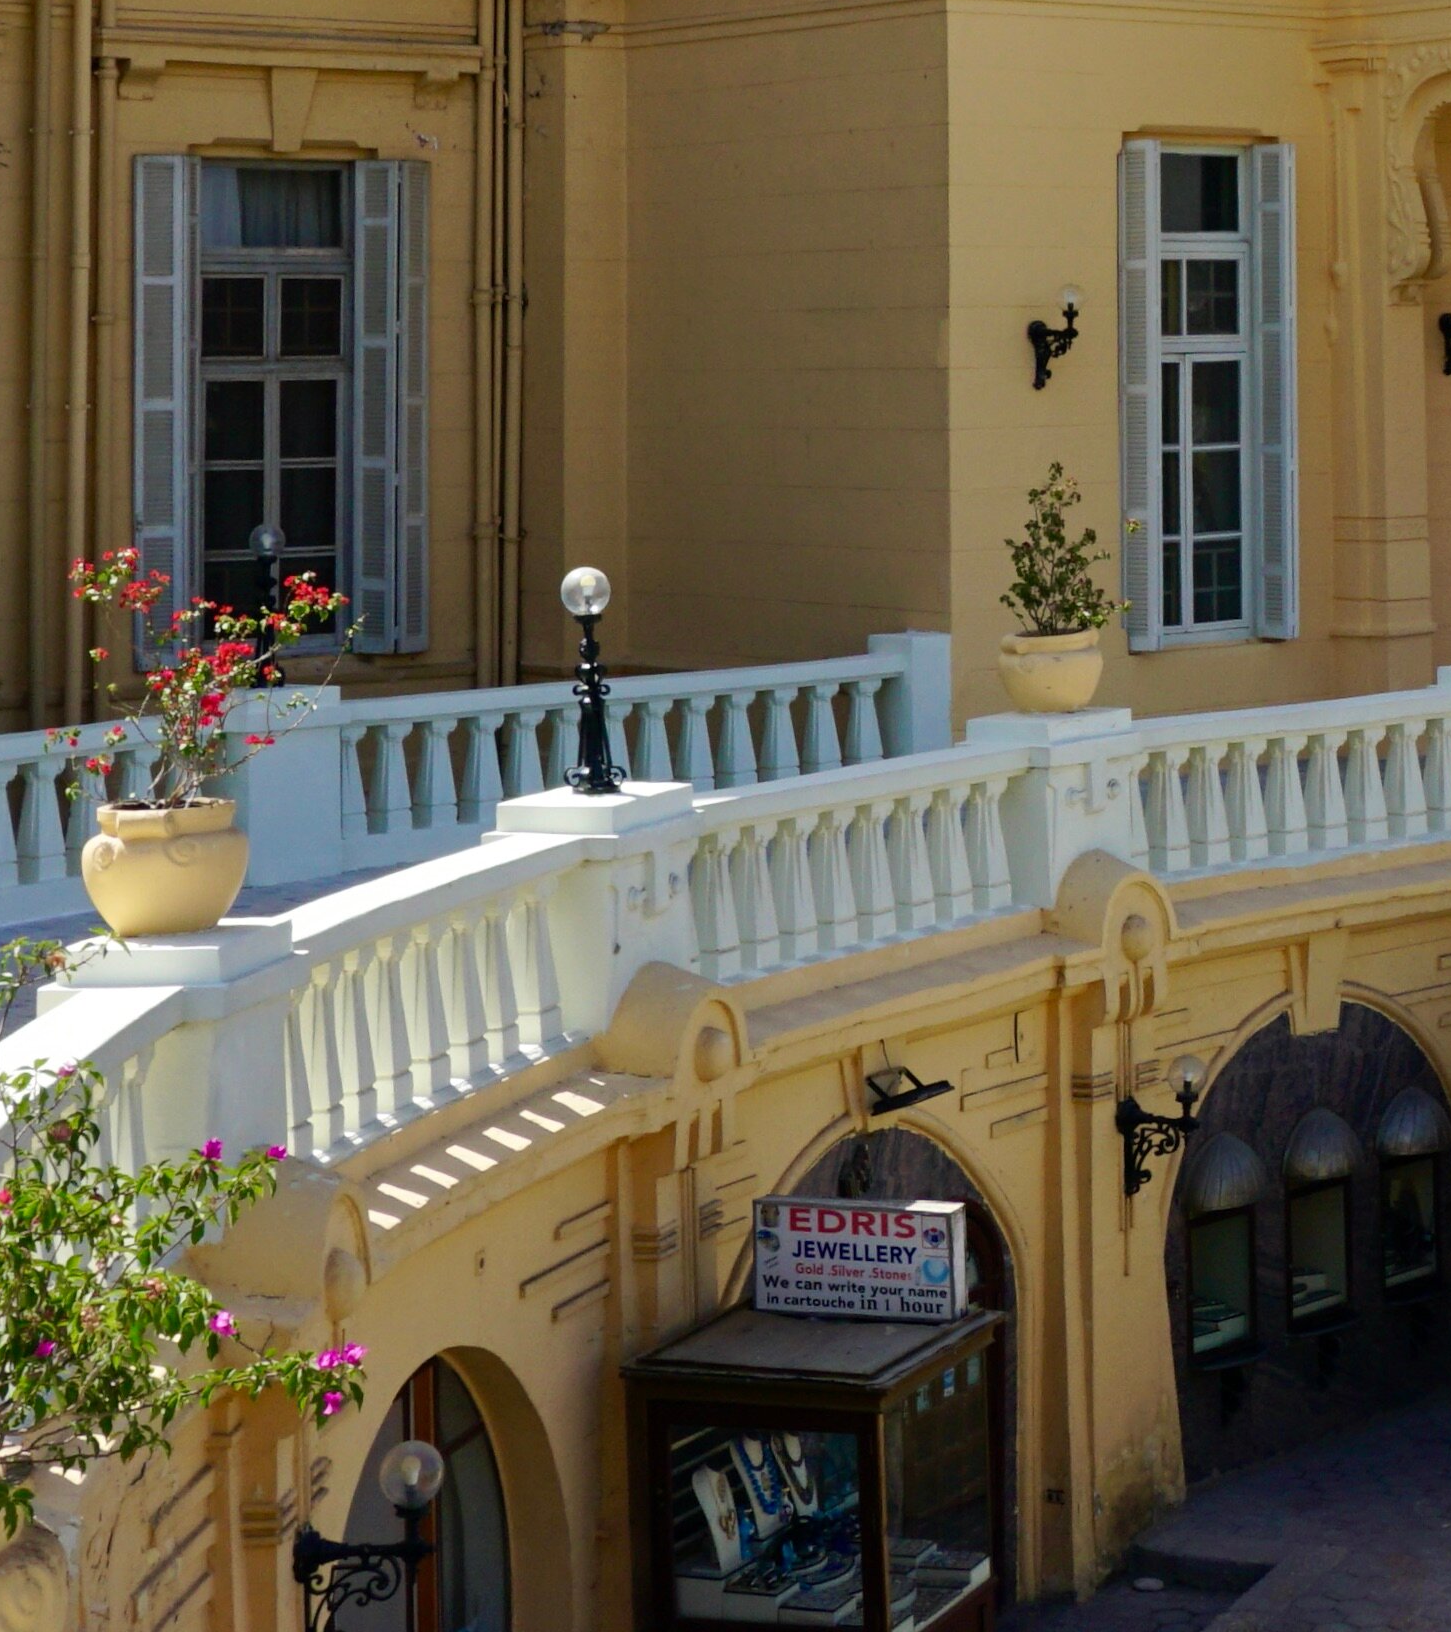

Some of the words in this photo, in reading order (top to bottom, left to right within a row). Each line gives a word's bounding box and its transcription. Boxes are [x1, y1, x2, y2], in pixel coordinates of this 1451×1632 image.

[789, 1207, 917, 1239] EDRIS
[792, 1240, 917, 1264] JEWELLERY
[795, 1263, 824, 1276] Gold
[763, 1275, 790, 1289] We
[795, 1279, 823, 1291] can
[828, 1281, 866, 1294] write
[870, 1285, 904, 1298] your
[908, 1288, 948, 1299] name
[766, 1293, 779, 1305] in
[783, 1294, 855, 1309] cartouche
[860, 1295, 878, 1310] in
[884, 1299, 891, 1311] 1
[900, 1297, 944, 1314] hour
